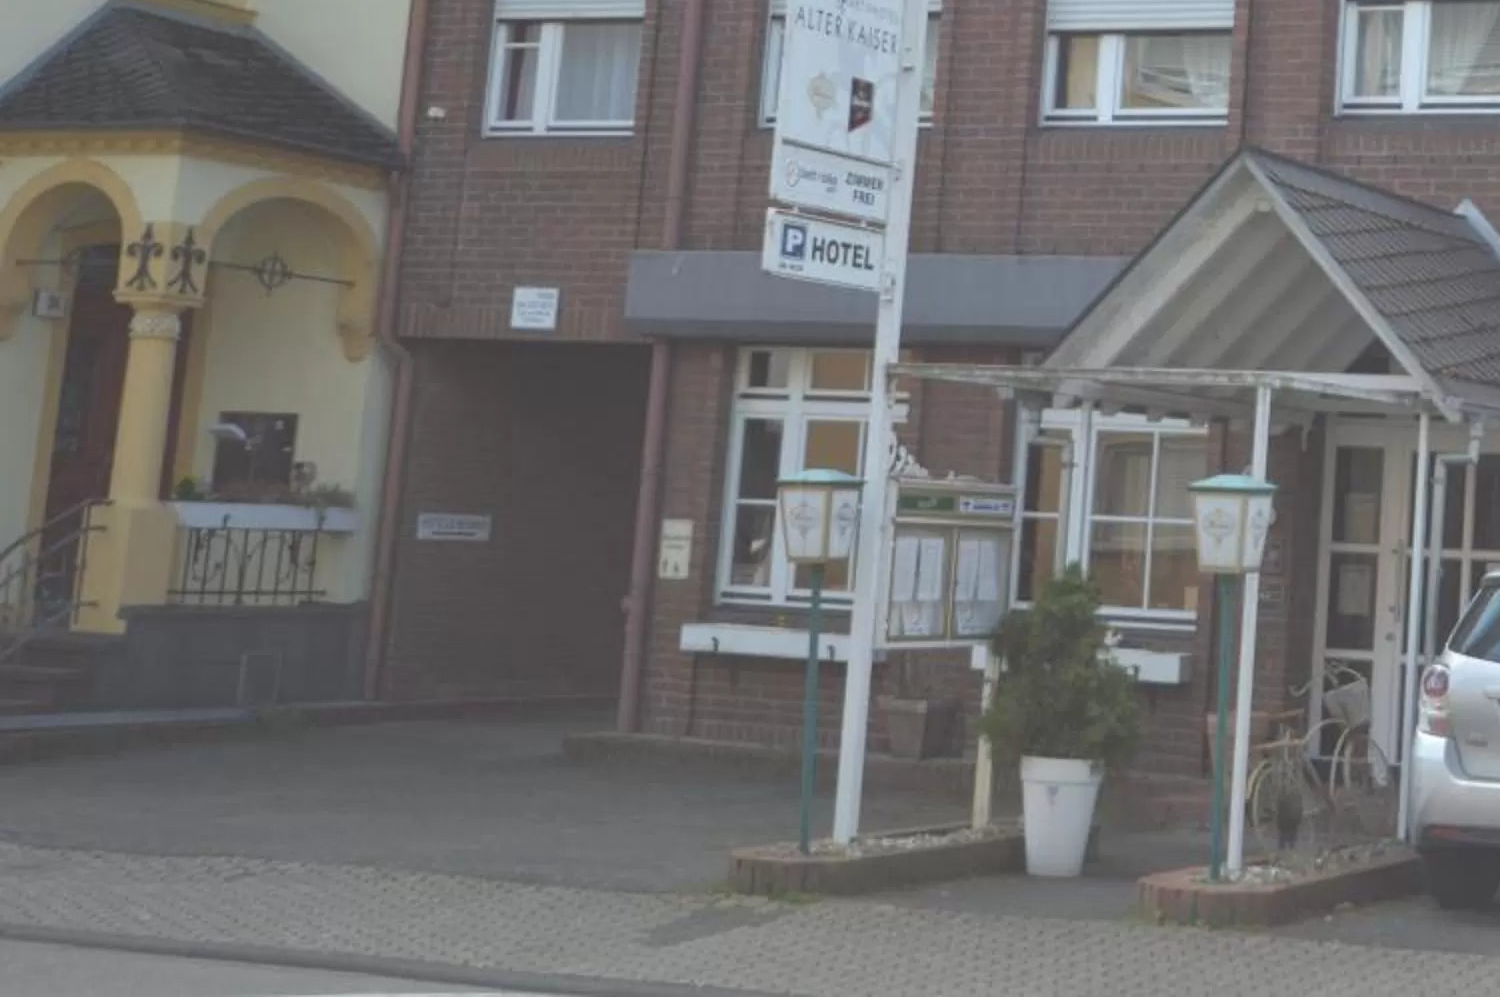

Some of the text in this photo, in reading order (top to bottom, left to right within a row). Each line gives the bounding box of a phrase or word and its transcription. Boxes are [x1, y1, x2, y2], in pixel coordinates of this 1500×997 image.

[794, 6, 843, 38] ALTER
[847, 19, 898, 55] KAISER
[786, 229, 875, 272] P HOTEL
